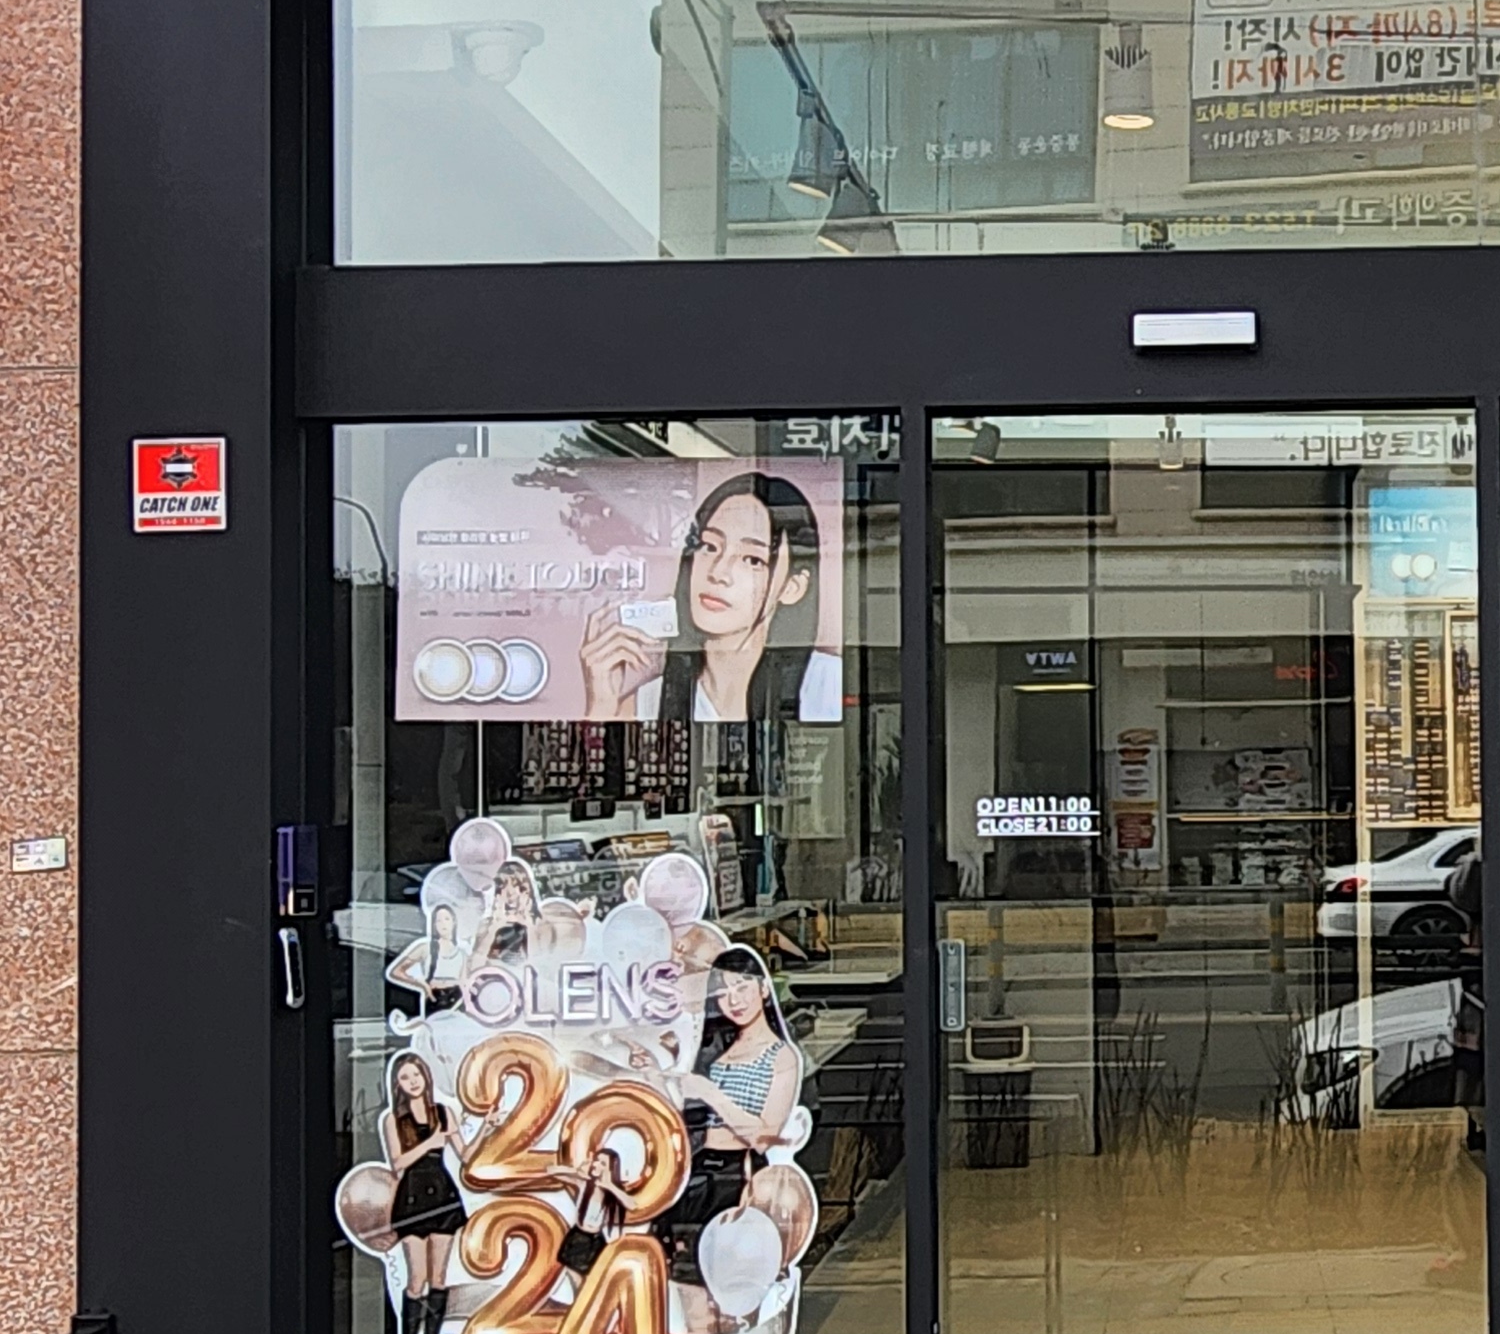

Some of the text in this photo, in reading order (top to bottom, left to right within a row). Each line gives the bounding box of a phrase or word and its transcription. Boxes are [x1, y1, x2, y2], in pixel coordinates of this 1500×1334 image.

[139, 495, 221, 514] CATCH ONE
[460, 960, 685, 1028] OLENS
